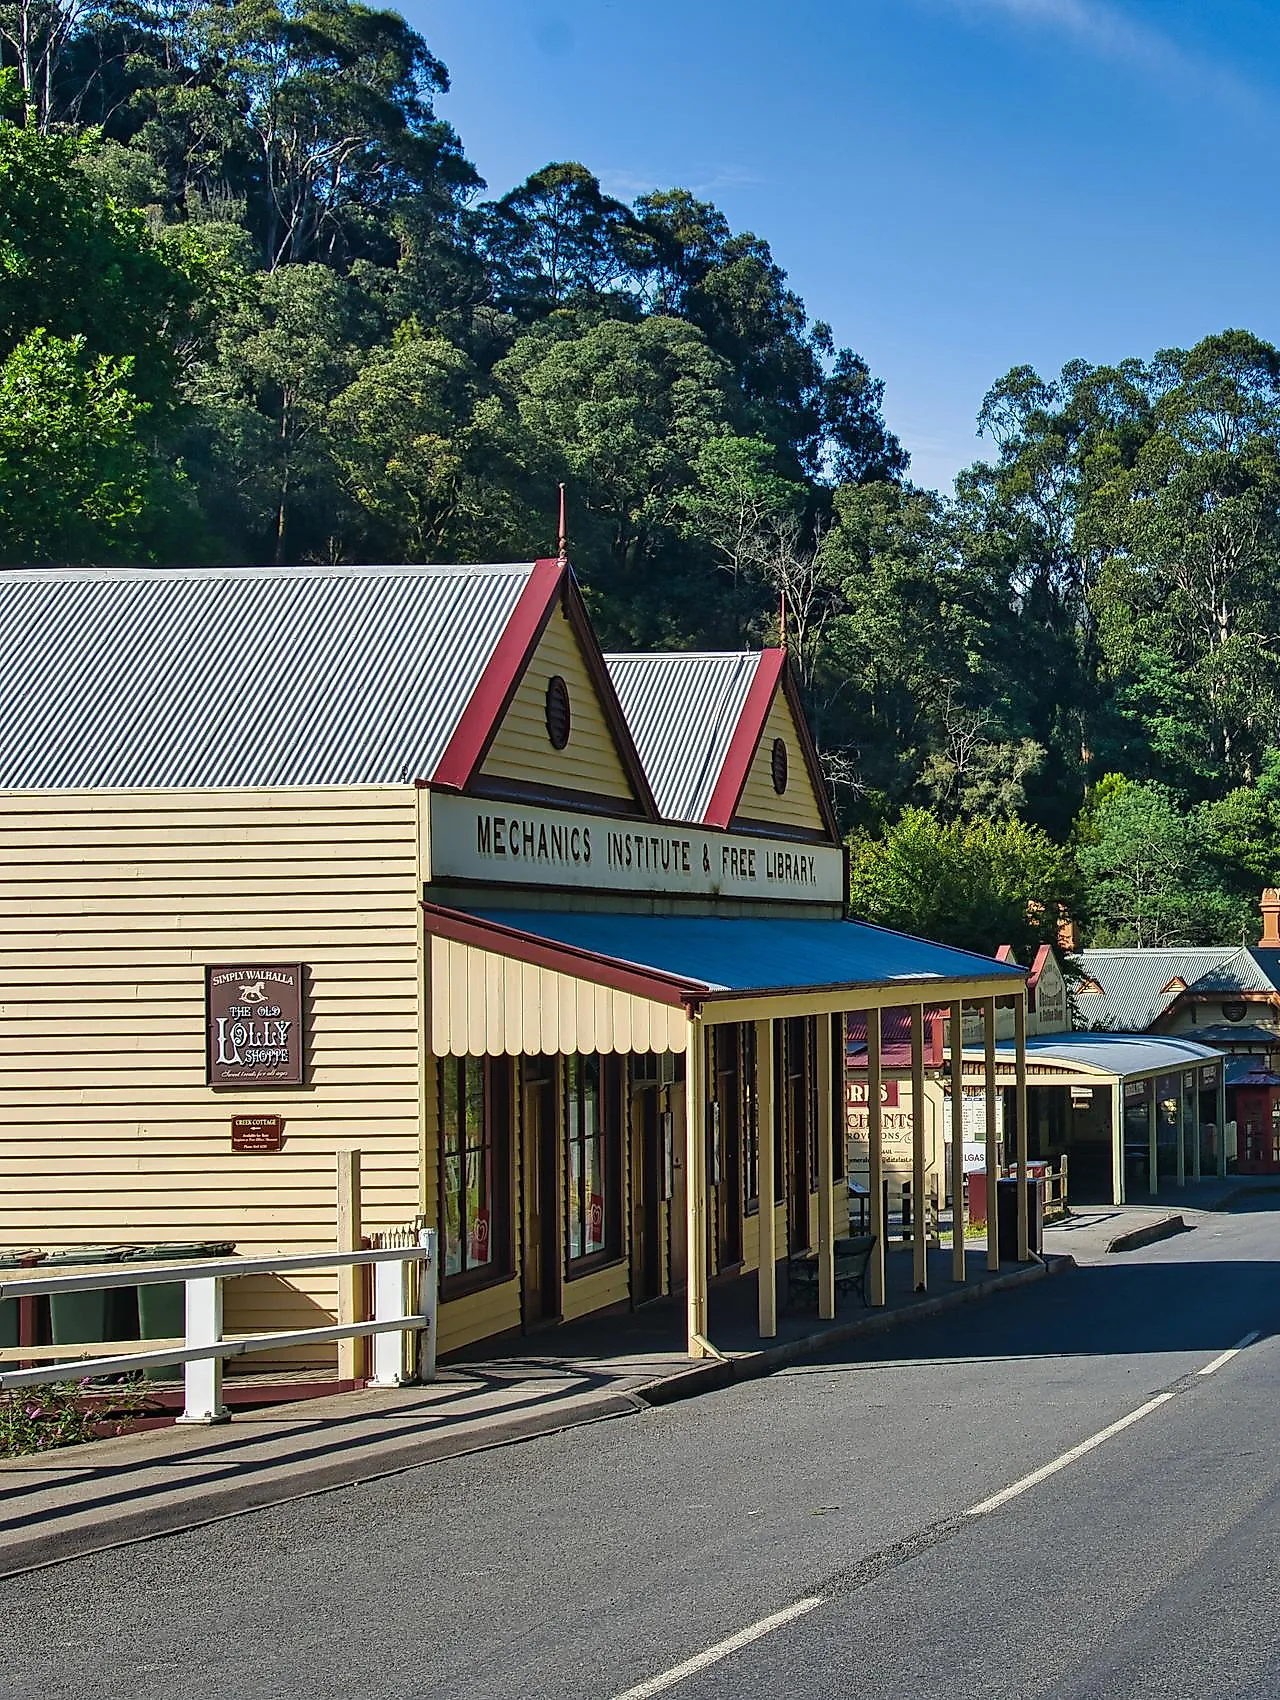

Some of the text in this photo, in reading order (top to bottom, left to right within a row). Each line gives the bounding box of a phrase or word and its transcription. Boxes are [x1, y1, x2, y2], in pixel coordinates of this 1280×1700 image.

[477, 815, 592, 864] MECHANICS
[607, 831, 691, 871] INSTITUTE
[702, 842, 711, 873] &
[721, 846, 757, 877] FREE
[213, 970, 294, 986] SIMPLY WALHALLA
[228, 1005, 281, 1020] THE OLD
[216, 1017, 292, 1065] LOLLY
[244, 1048, 289, 1067] SHOPPE
